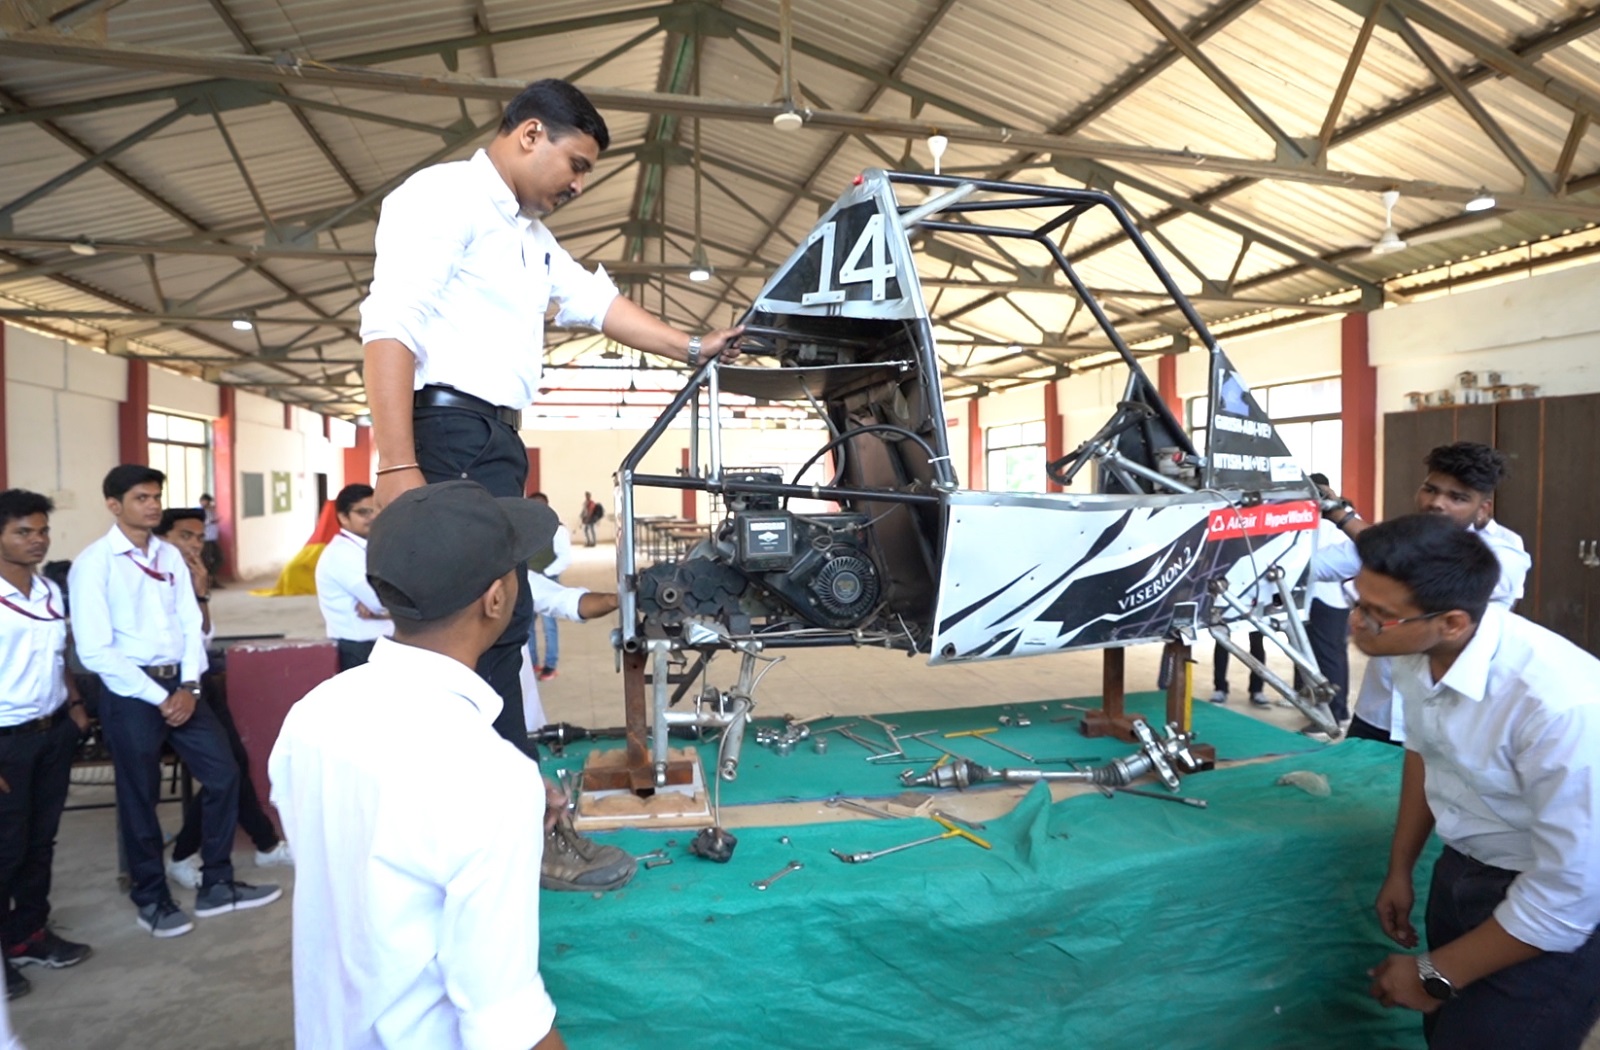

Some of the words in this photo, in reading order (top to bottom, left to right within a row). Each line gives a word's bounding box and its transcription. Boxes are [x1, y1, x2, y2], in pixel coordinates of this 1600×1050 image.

[802, 213, 896, 305] 14
[1265, 510, 1314, 527] HyperWorks
[1118, 556, 1183, 610] VISERION
[1183, 546, 1192, 564] 2
